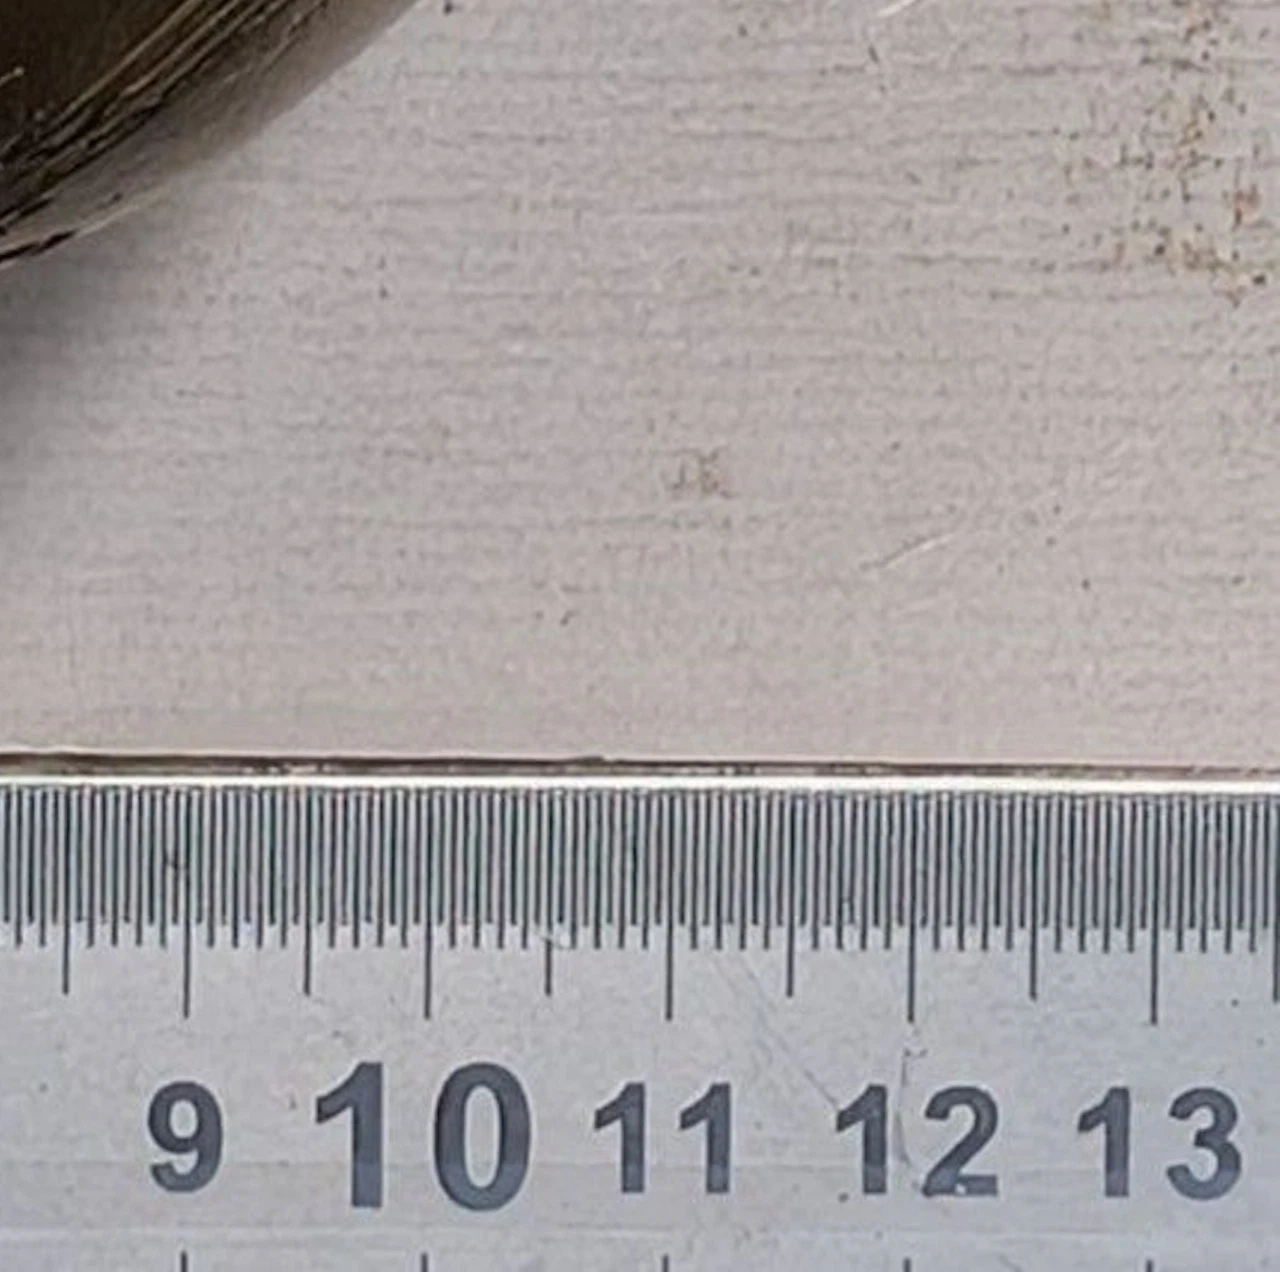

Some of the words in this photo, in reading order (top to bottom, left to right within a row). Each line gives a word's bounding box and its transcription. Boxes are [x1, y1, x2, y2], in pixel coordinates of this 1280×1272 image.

[148, 1082, 223, 1192] 9
[316, 1062, 530, 1211] 10
[594, 1083, 730, 1194] 11
[836, 1084, 998, 1198] 12
[1077, 1087, 1241, 1200] 13
